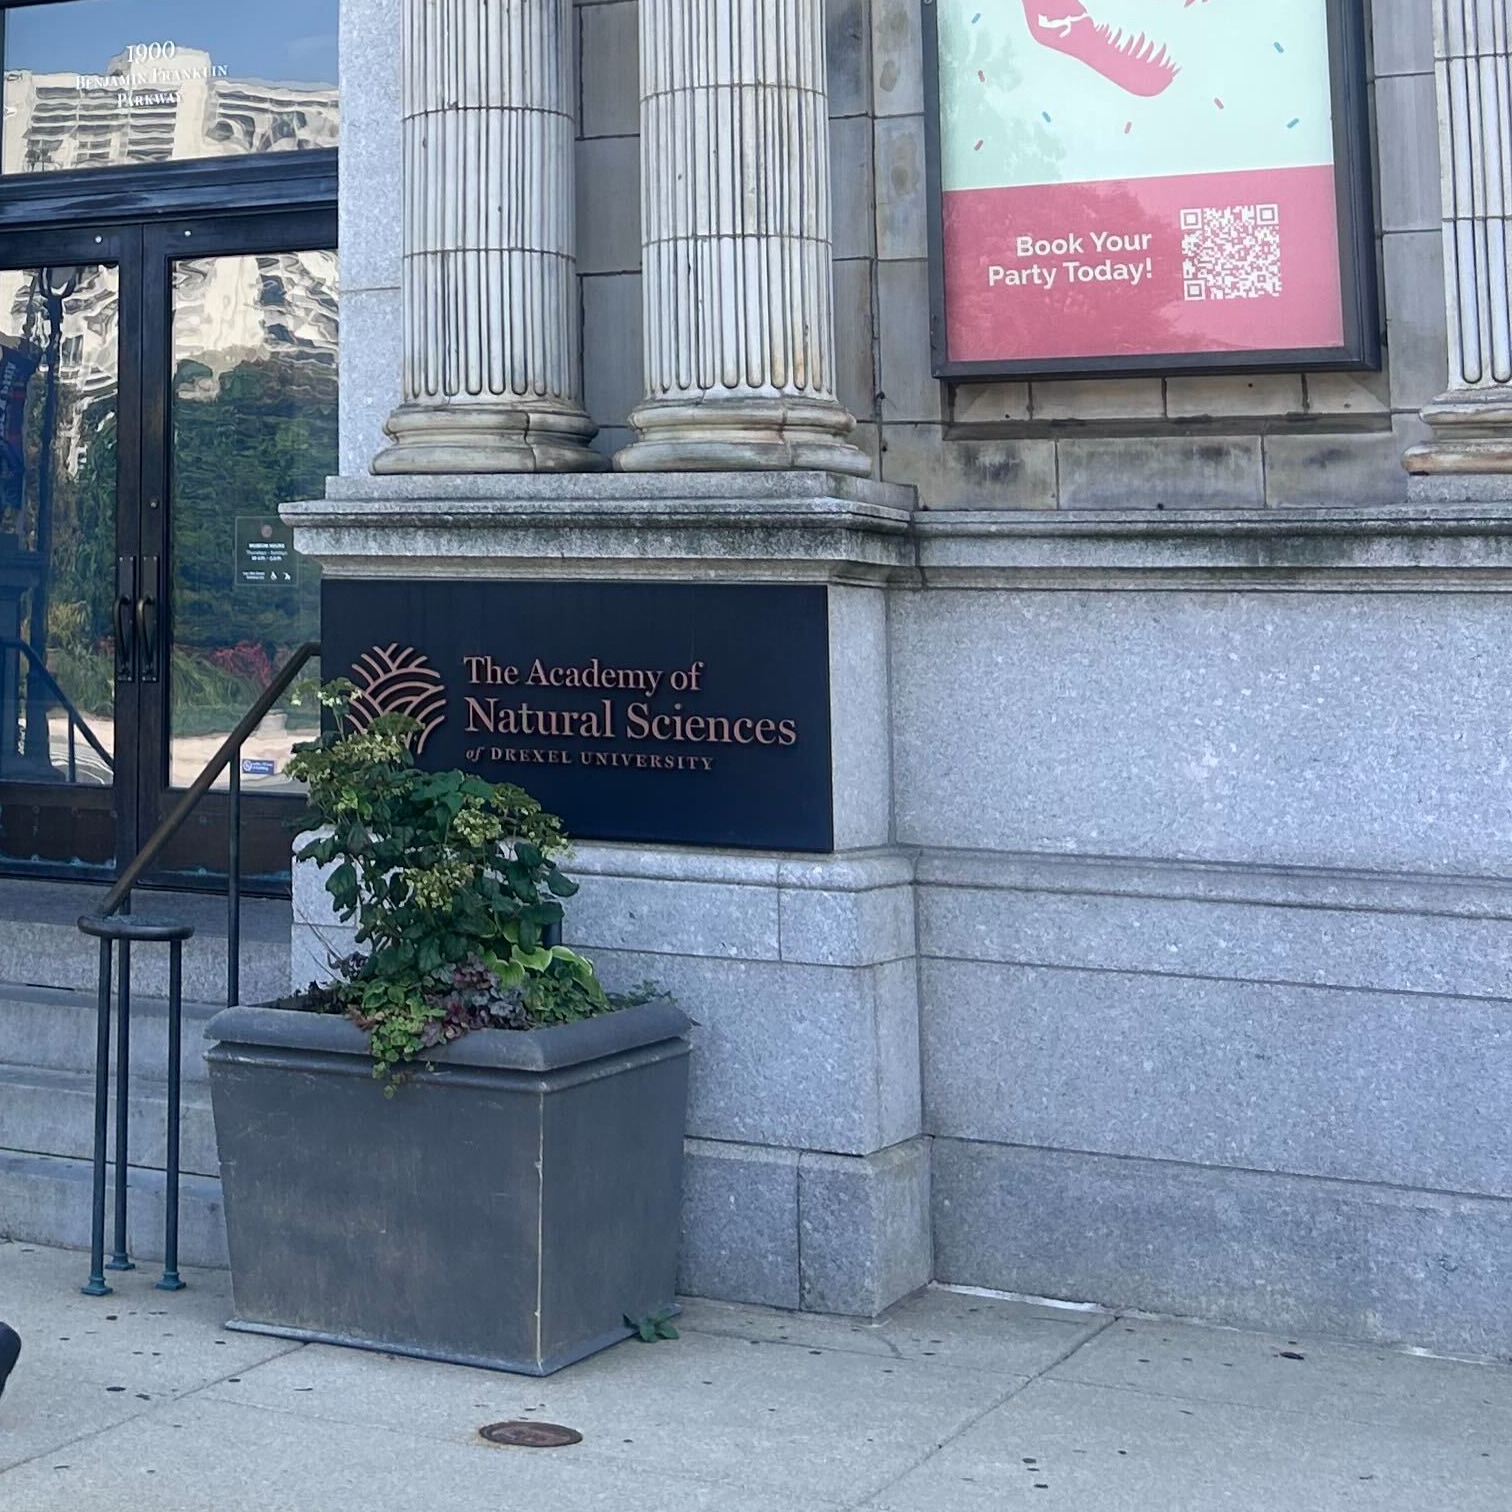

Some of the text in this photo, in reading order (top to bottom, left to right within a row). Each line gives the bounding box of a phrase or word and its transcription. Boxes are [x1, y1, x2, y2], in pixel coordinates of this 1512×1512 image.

[126, 40, 176, 64] 1900
[1016, 231, 1152, 257] Book Your
[988, 257, 1152, 290] Party Today!
[463, 656, 705, 697] The Academy of
[464, 696, 798, 747] Natural Sciences
[465, 746, 714, 771] of DREXEL UNIVERSITY
